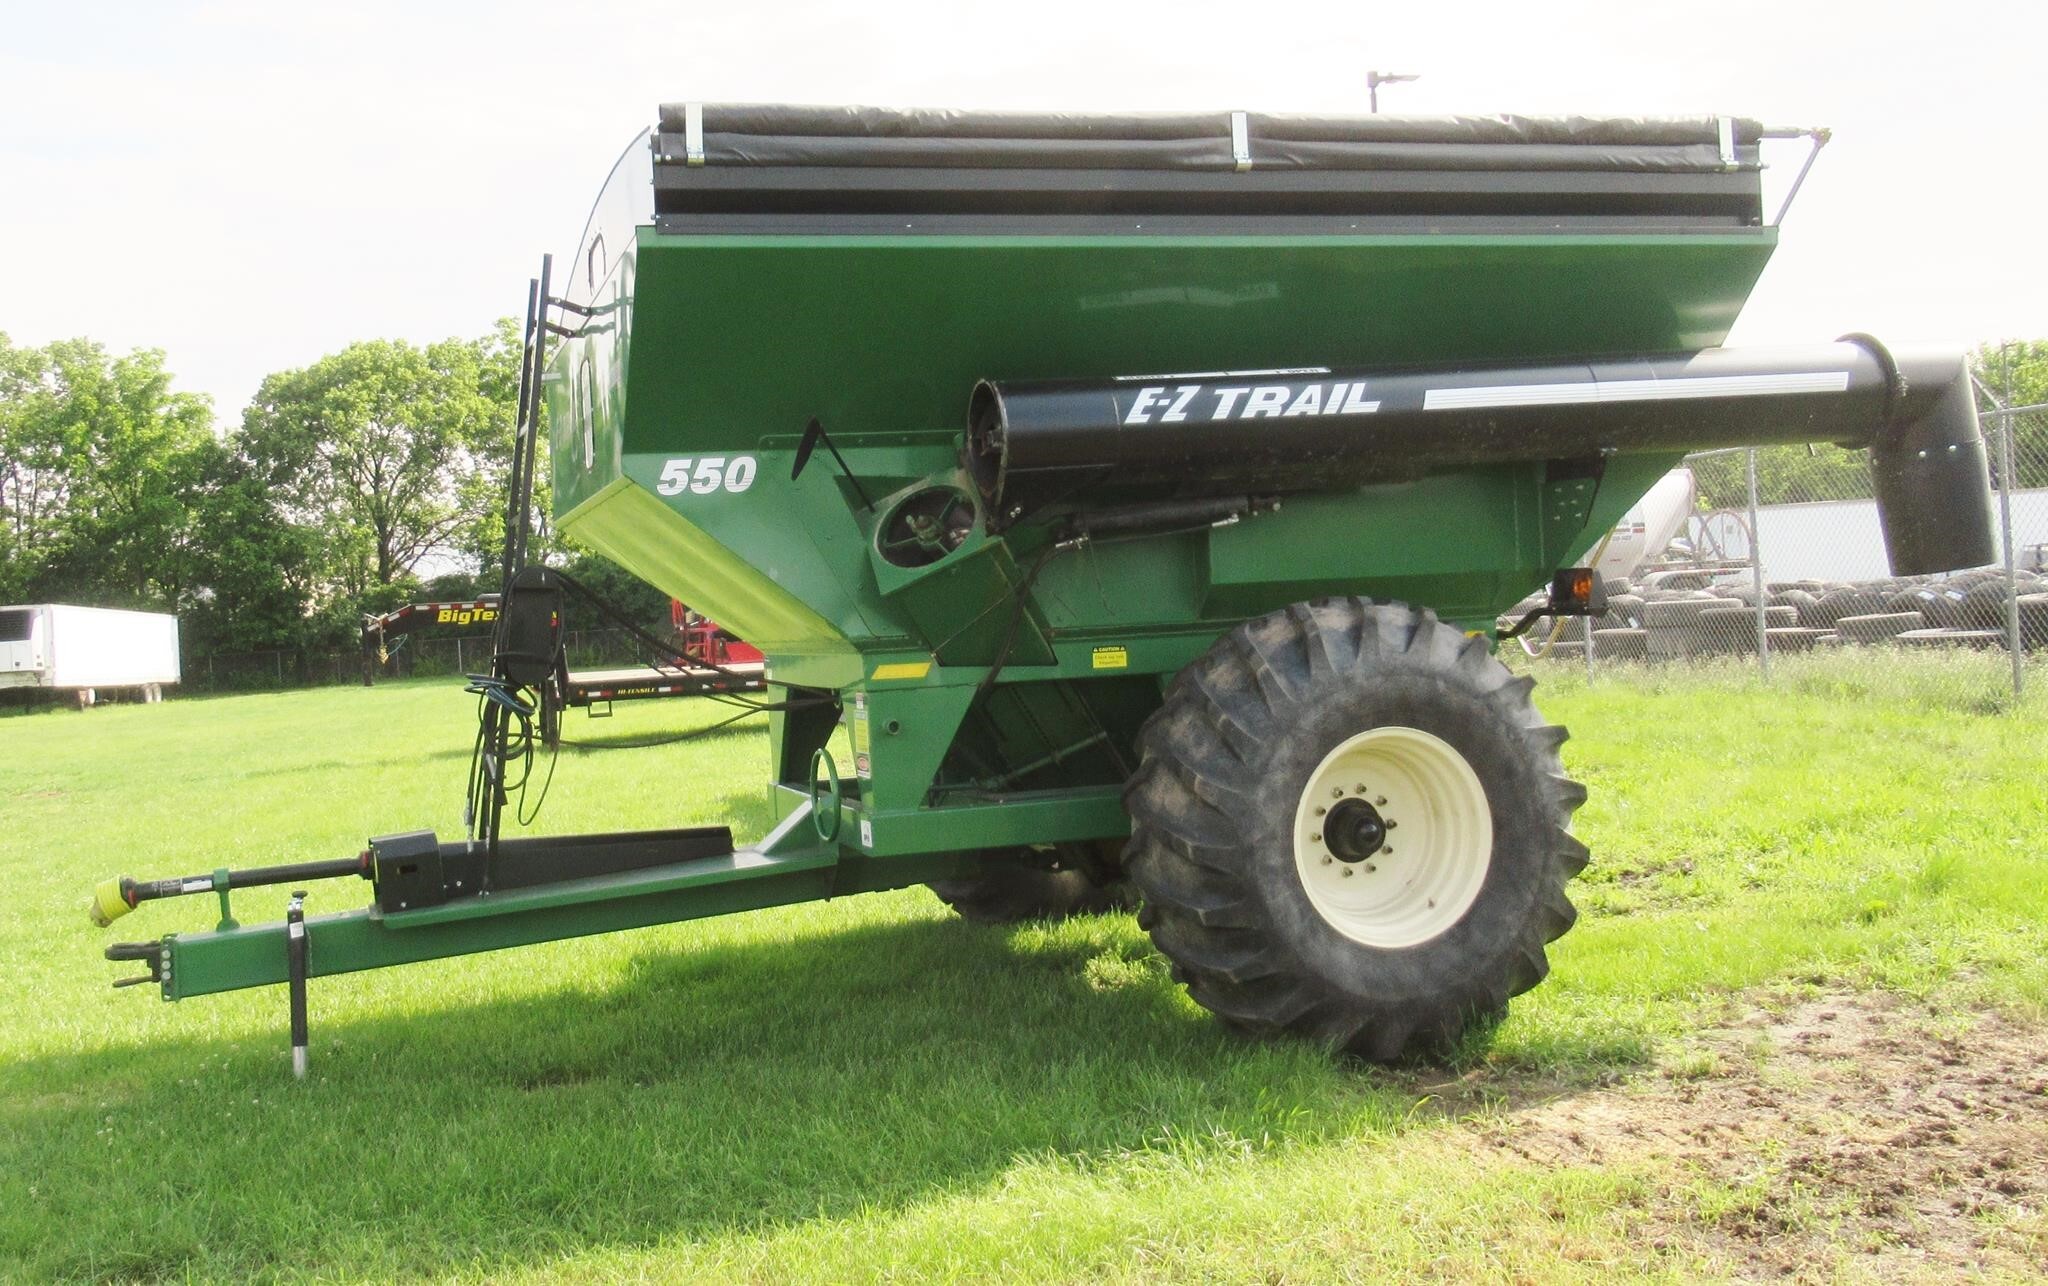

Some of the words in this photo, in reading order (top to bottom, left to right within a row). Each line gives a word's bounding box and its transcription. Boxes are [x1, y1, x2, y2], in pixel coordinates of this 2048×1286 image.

[1124, 385, 1201, 424] E-Z
[1211, 383, 1381, 420] TRAIL
[656, 456, 757, 496] 550
